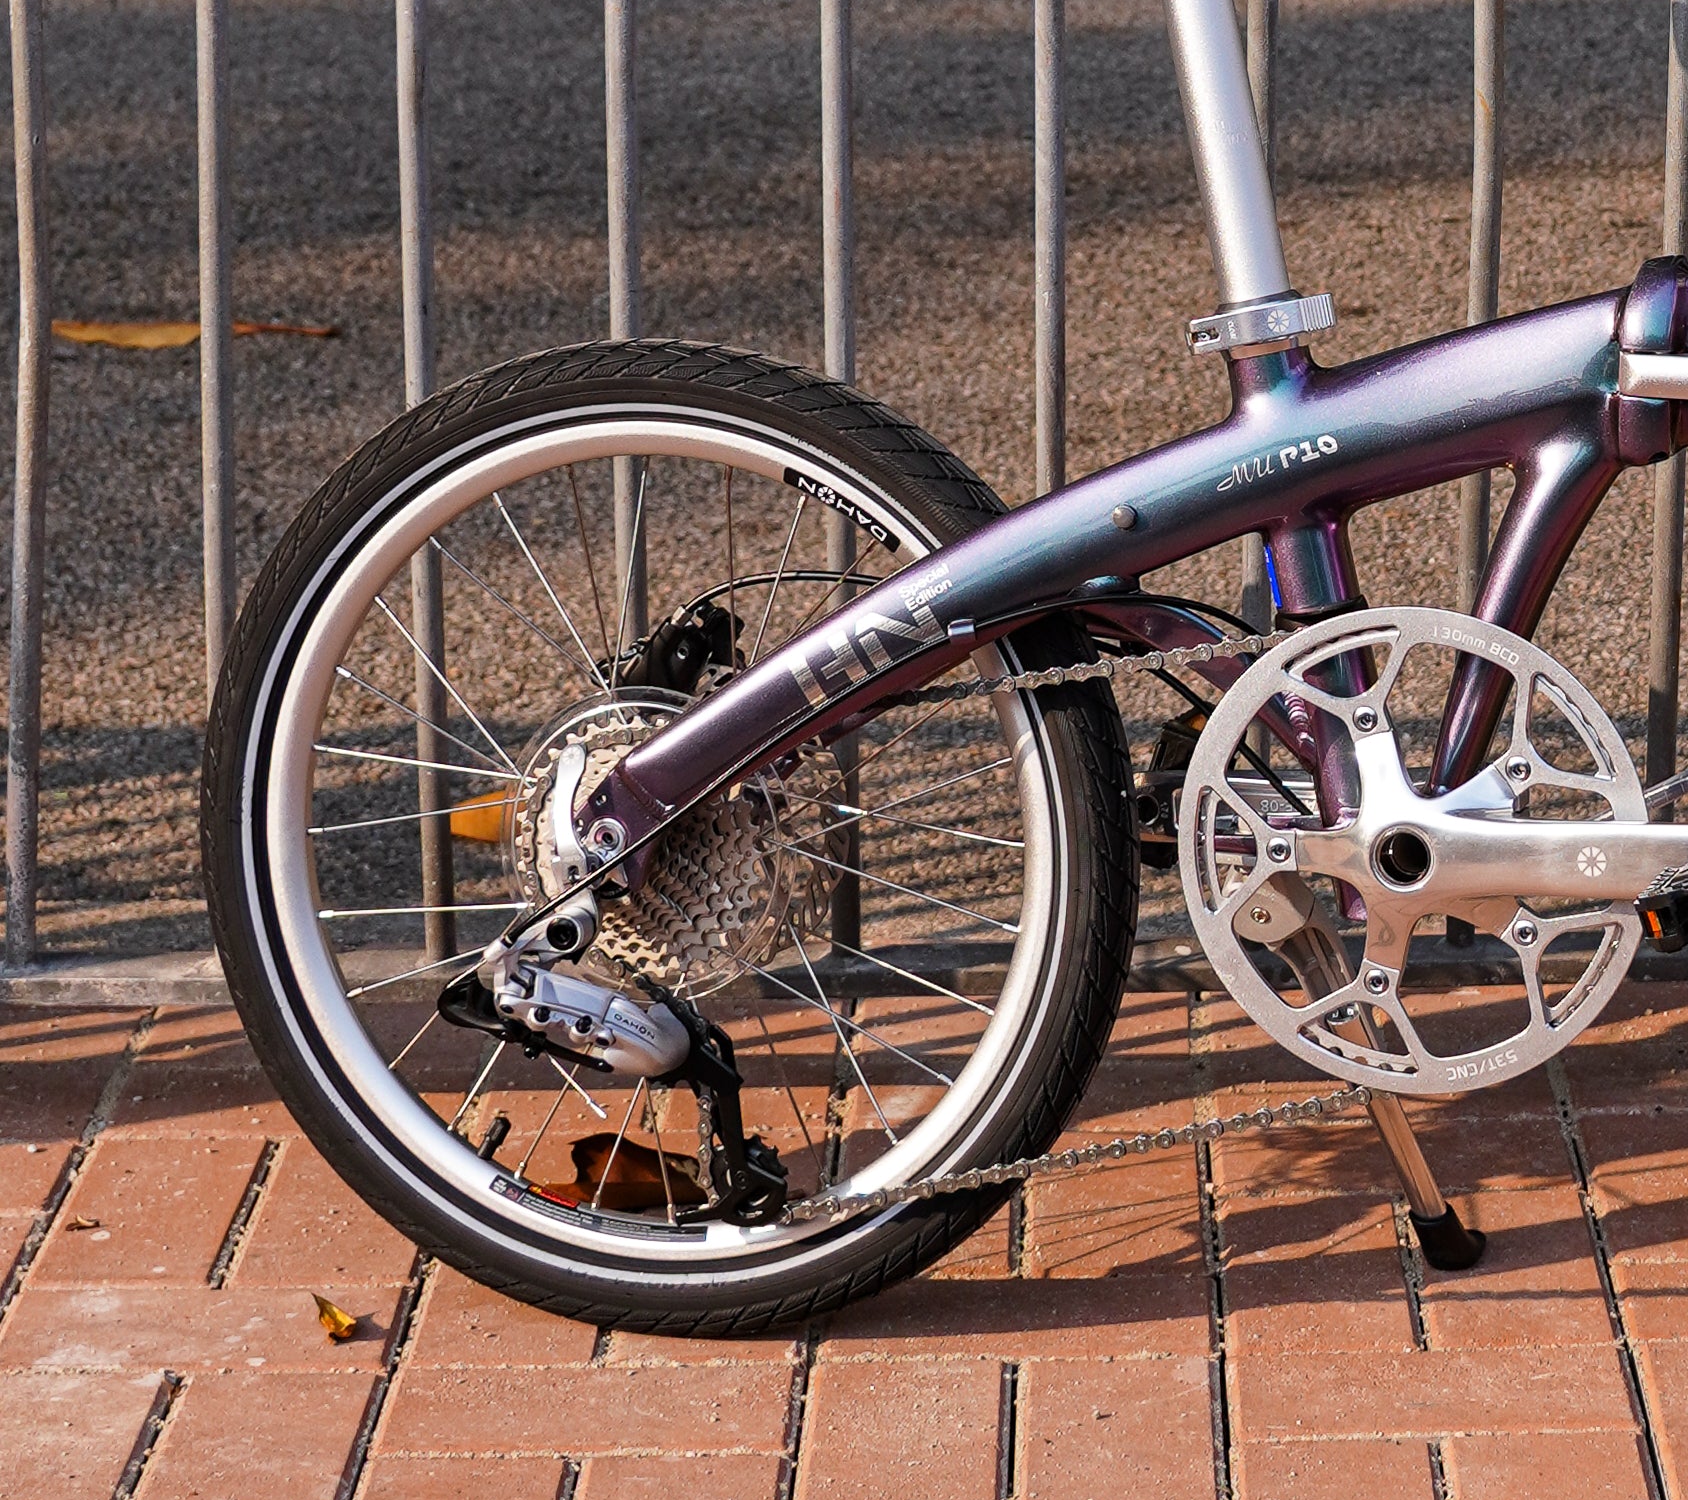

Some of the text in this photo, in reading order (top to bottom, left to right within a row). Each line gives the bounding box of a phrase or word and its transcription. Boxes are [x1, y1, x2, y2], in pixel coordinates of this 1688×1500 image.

[1279, 434, 1339, 469] P10
[797, 476, 888, 542] DAHON
[899, 562, 951, 600] Special
[904, 578, 953, 612] Edition
[1432, 626, 1520, 666] 130mm BCD
[613, 1013, 656, 1040] DAHON
[1446, 1048, 1518, 1081] 53T/CNC
